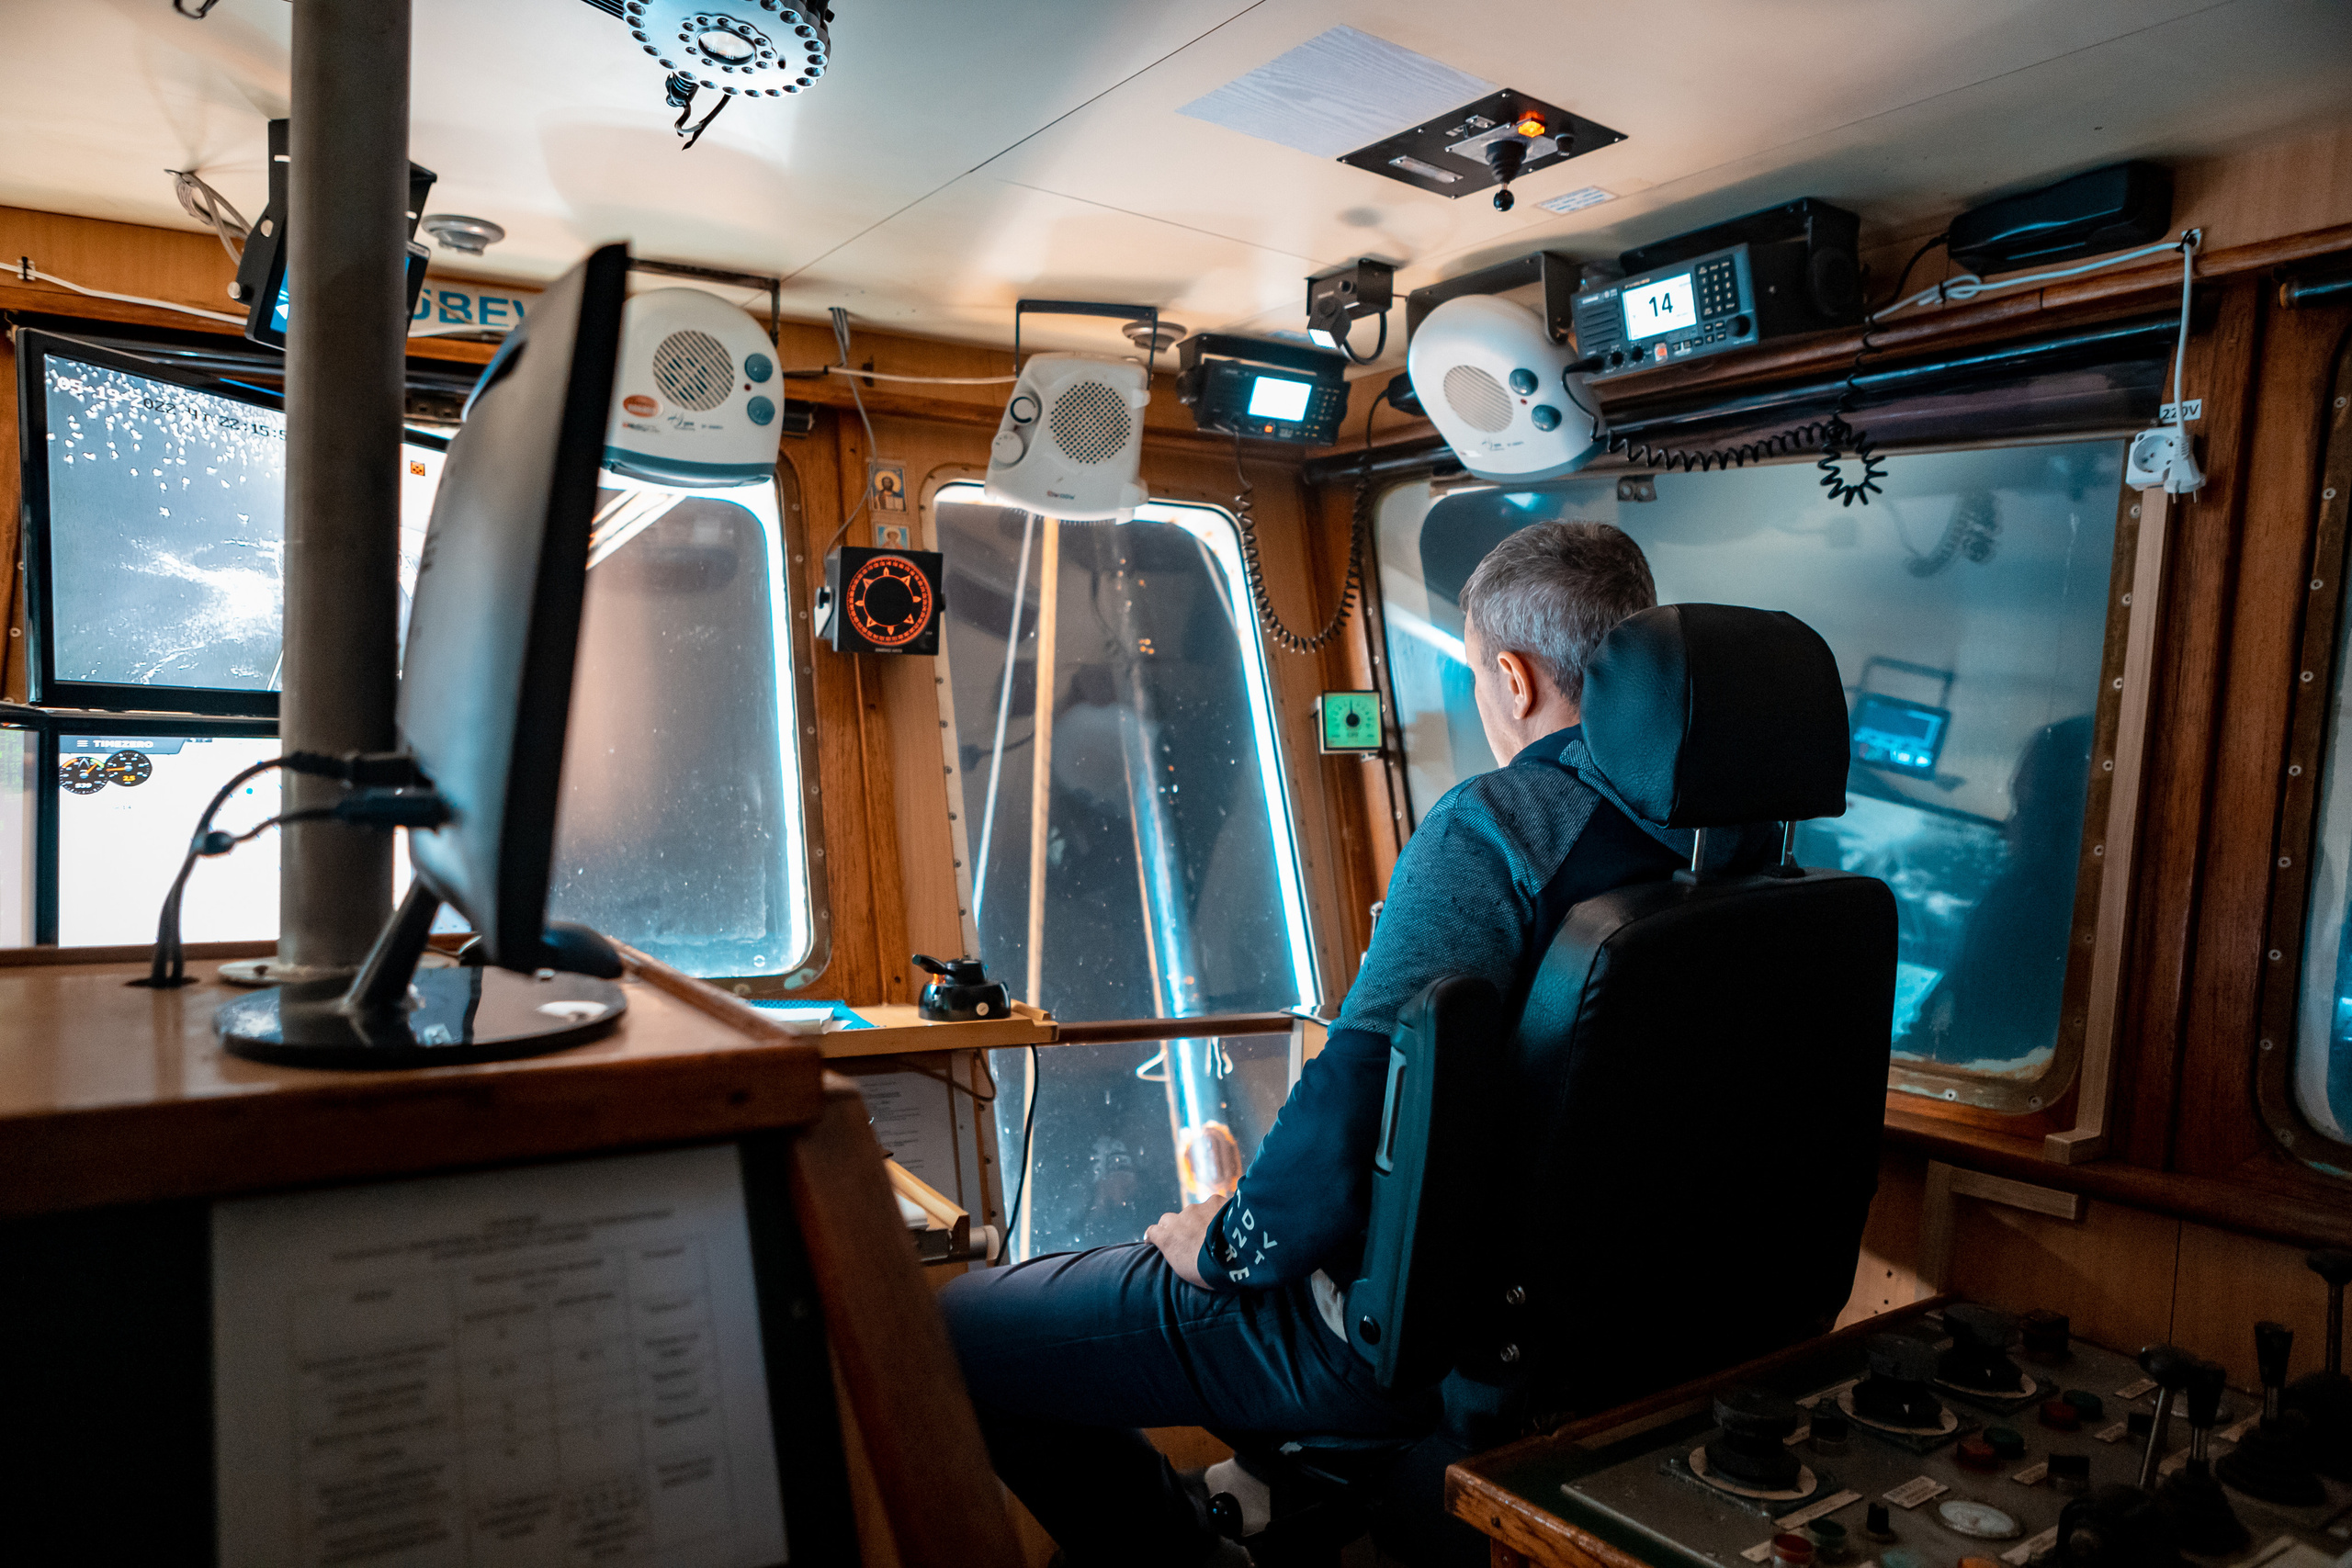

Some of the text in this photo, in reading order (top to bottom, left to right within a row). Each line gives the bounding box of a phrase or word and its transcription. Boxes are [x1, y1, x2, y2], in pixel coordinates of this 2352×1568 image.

[1648, 292, 1673, 317] 14
[57, 376, 176, 415] 05-19-2022
[93, 739, 154, 749] TIMEZERO
